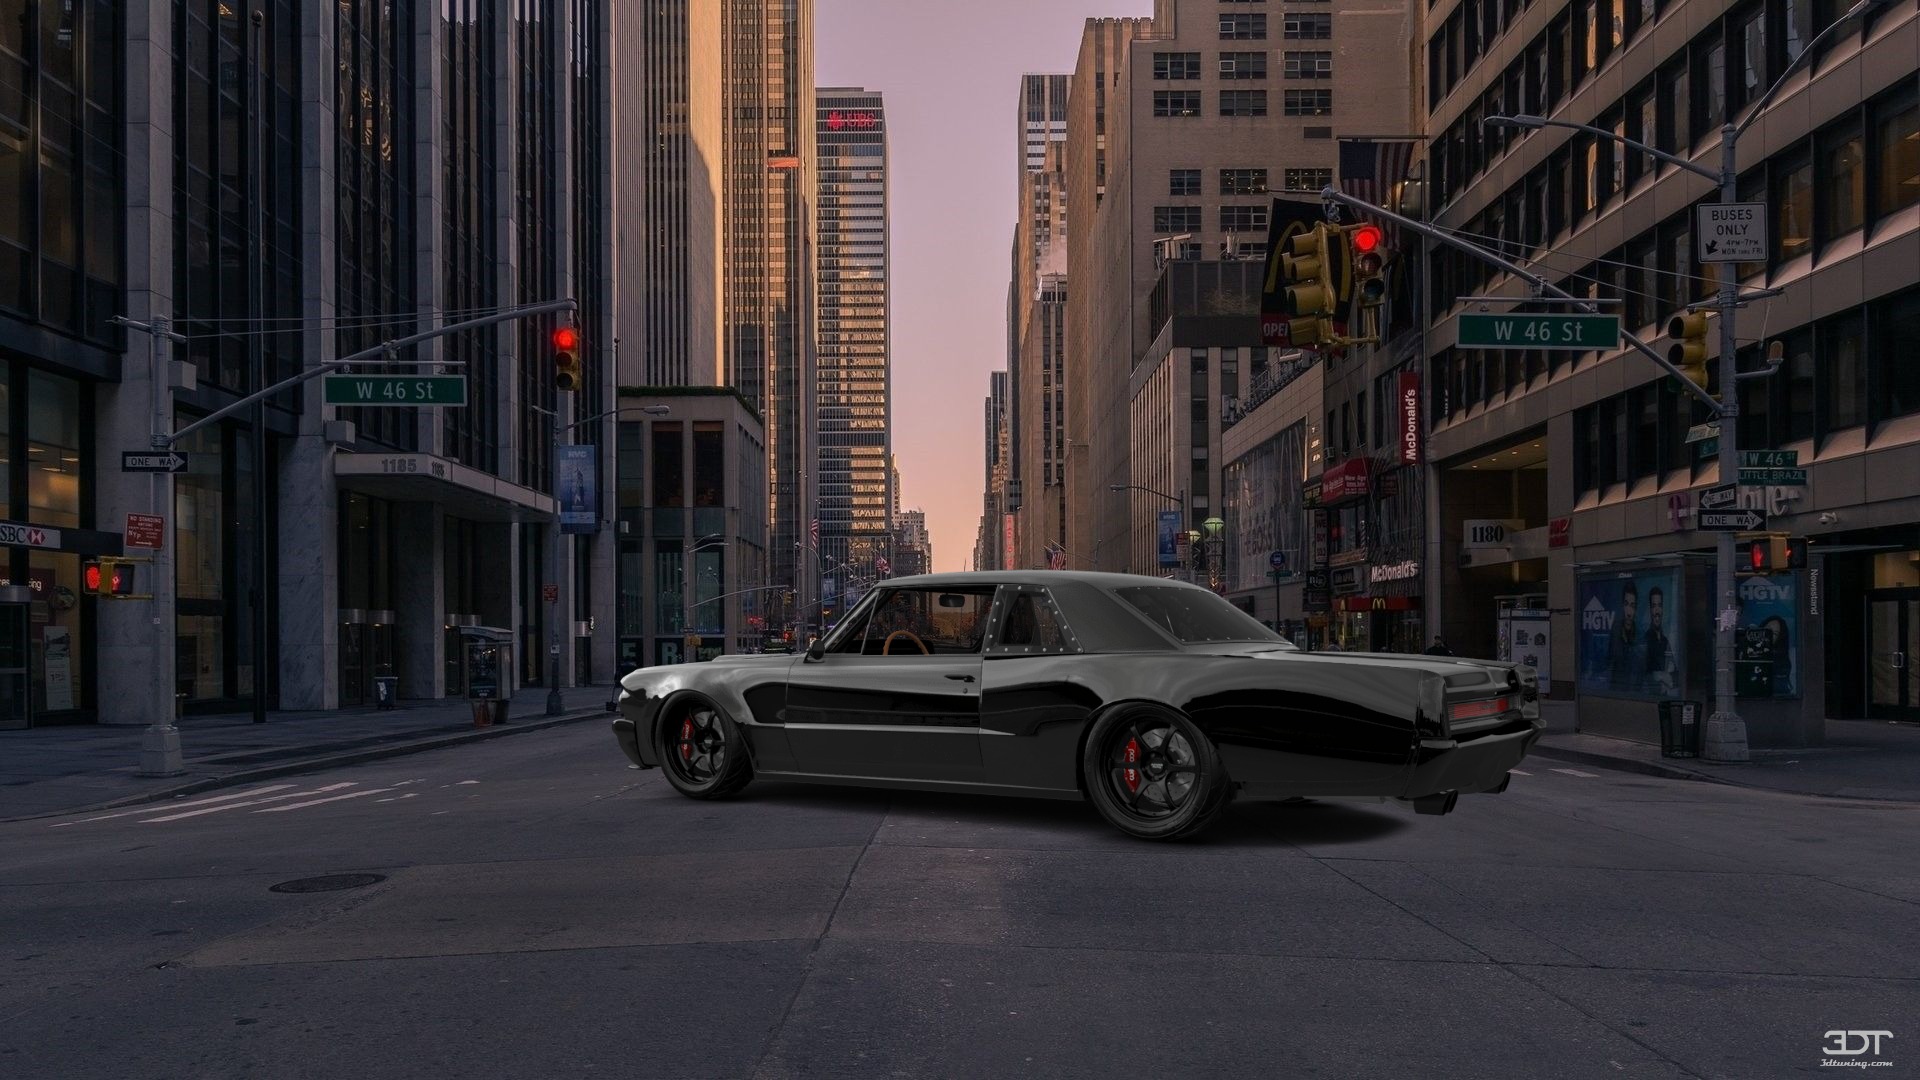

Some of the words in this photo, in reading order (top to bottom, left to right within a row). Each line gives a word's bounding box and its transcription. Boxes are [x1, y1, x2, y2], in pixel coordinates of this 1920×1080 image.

[1711, 209, 1753, 221] BUSES
[1716, 224, 1749, 236] ONLY
[1726, 238, 1759, 246] 4PM-7PM
[1721, 247, 1737, 255] MON
[1752, 247, 1763, 255] FRI
[1494, 320, 1514, 341] W
[1524, 321, 1551, 342] 46
[1561, 321, 1584, 342] St
[356, 381, 374, 400] W
[382, 381, 407, 400] 46
[415, 381, 435, 400] St
[1404, 388, 1417, 461] McDonald's
[130, 457, 151, 466] ONE
[158, 457, 178, 466] WAY
[381, 458, 417, 473] 1185
[1748, 452, 1761, 467] W
[1765, 451, 1784, 467] 46
[1738, 470, 1768, 481] LITTLE
[1771, 470, 1806, 481] BRAZIL
[1719, 489, 1733, 500] WAY
[1707, 515, 1728, 525] ONE
[1735, 515, 1757, 525] WAY
[0, 526, 26, 543] SBC
[1471, 525, 1504, 543] 1180
[1370, 559, 1419, 583] McDonald's
[1740, 585, 1791, 601] HGTV
[1809, 568, 1819, 615] Newsstand
[1582, 610, 1616, 631] HGTV
